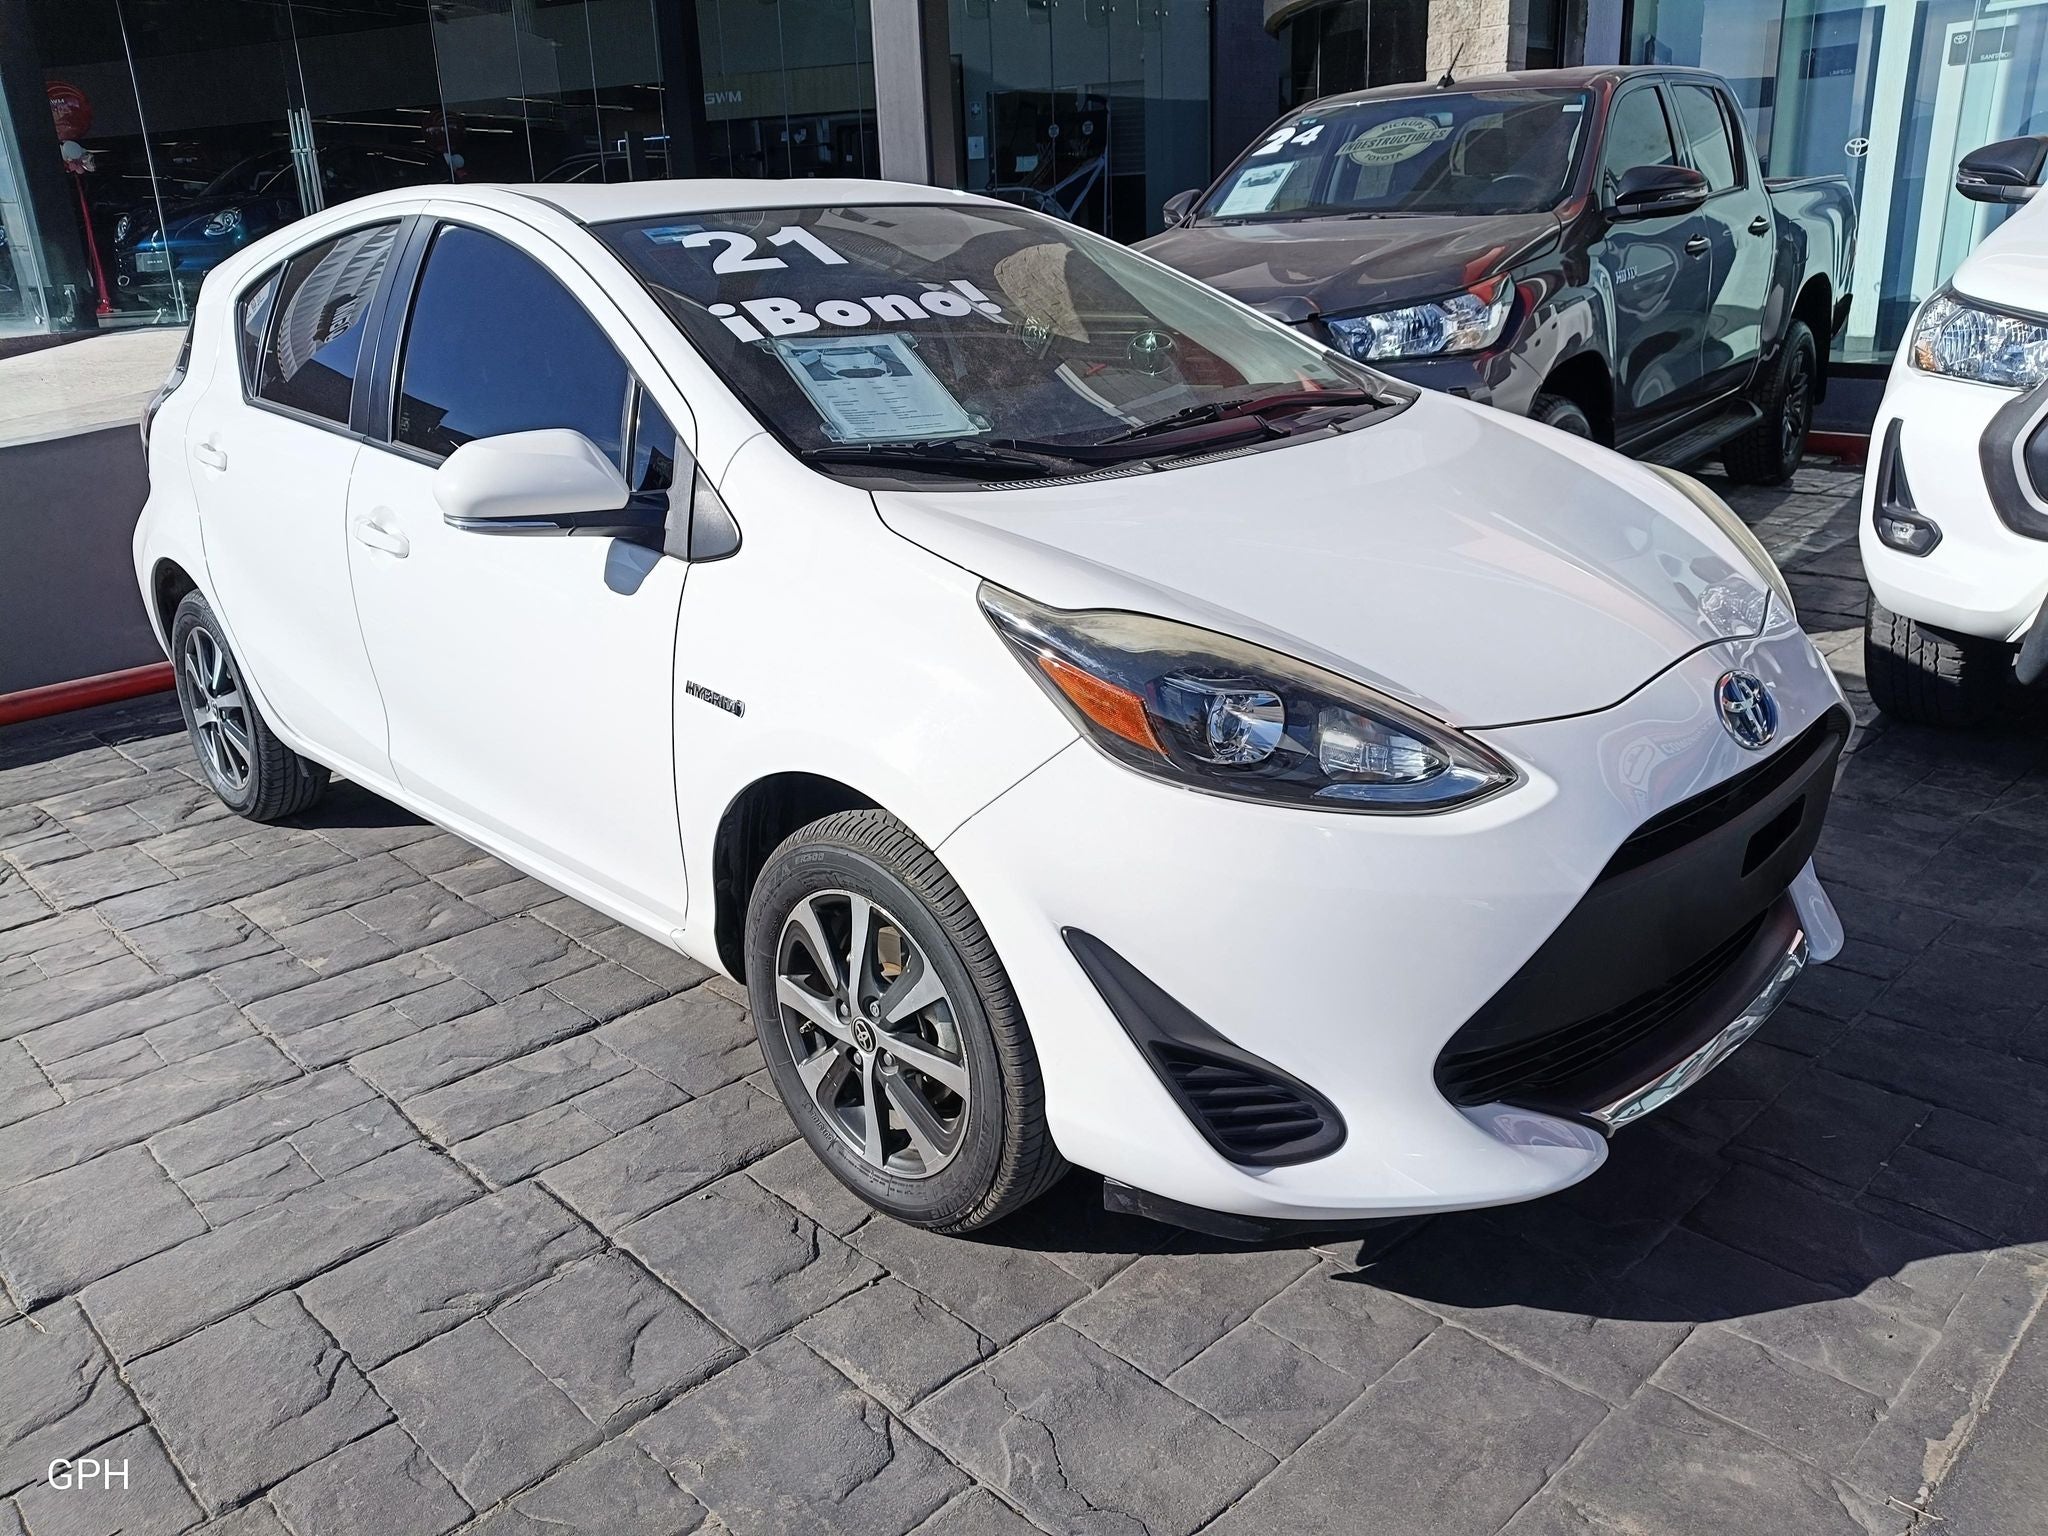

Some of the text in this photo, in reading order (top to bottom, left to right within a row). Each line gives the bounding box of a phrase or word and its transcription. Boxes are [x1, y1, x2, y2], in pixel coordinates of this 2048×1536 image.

[703, 90, 742, 105] GWM
[1381, 120, 1428, 132] PICKUPS
[1252, 124, 1325, 157] 24
[1341, 128, 1448, 153] INDESTRUCTIBLES
[1364, 152, 1405, 162] TOYOTA
[681, 225, 850, 275] 21
[685, 679, 737, 715] HYBRID
